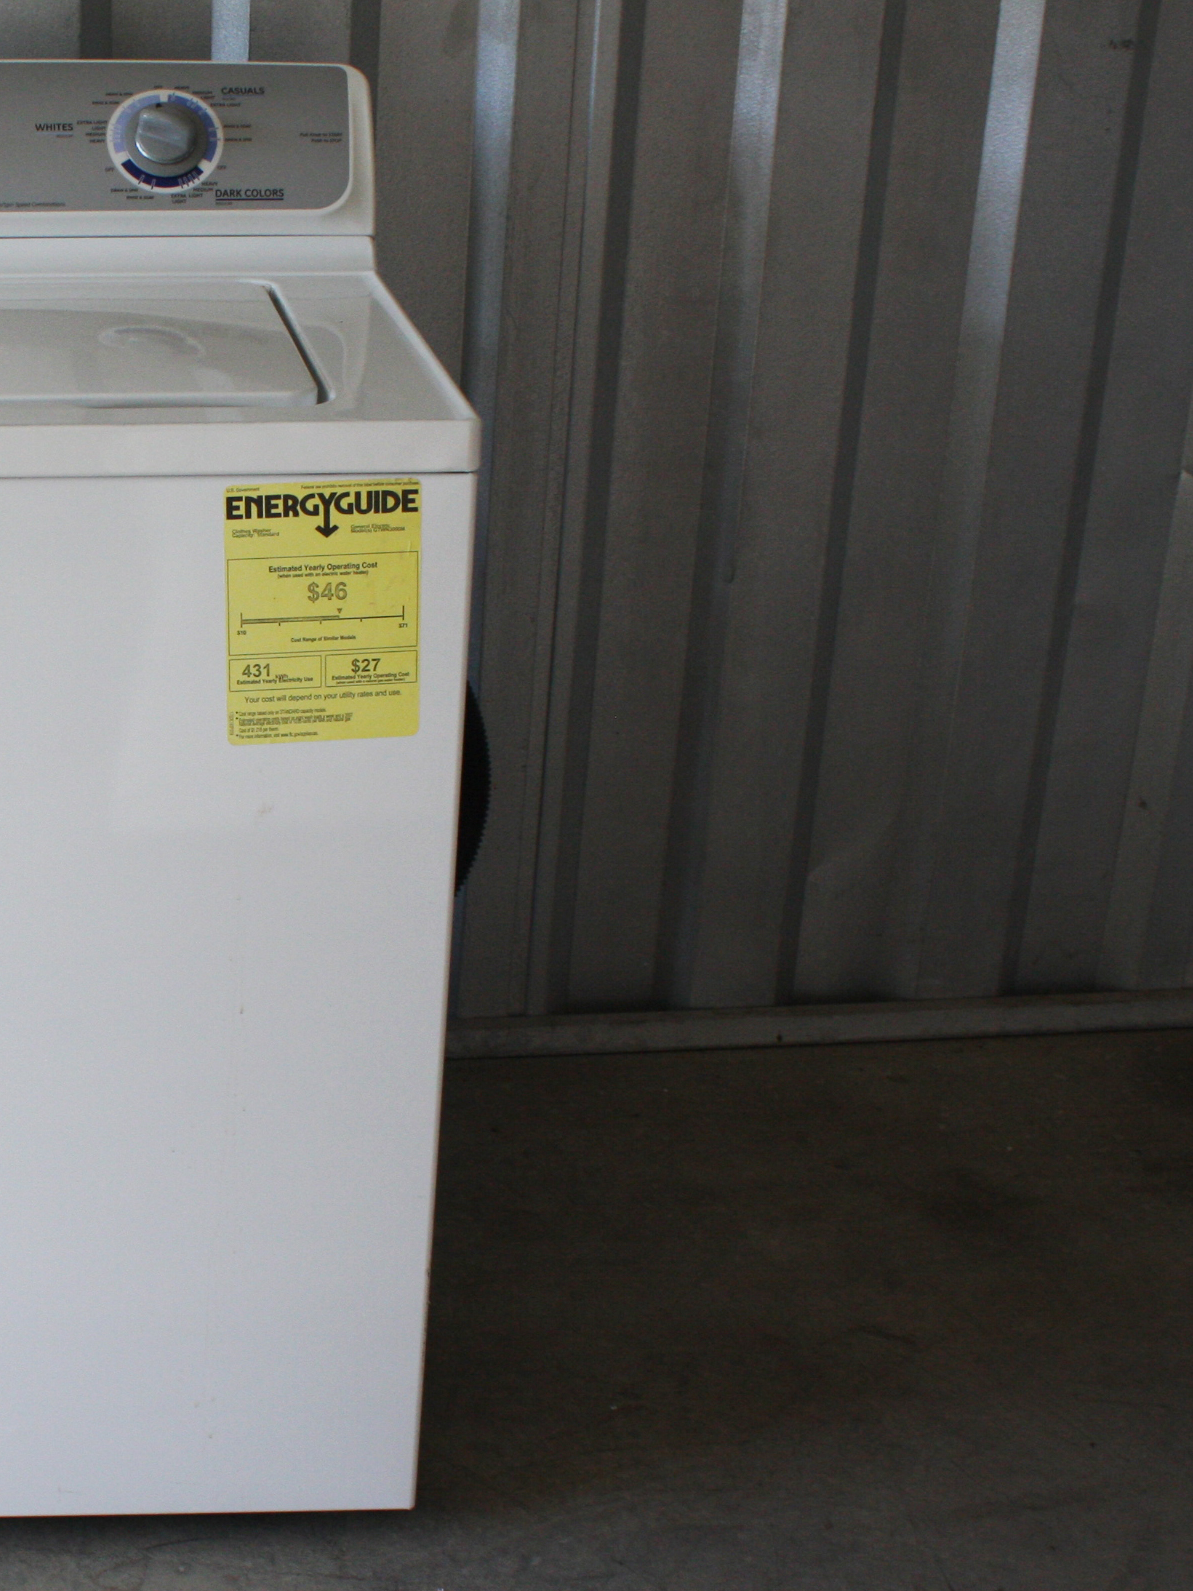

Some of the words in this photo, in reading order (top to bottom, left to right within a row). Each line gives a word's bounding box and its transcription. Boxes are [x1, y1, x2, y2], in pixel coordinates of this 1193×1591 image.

[221, 87, 265, 95] CASUALS
[35, 123, 74, 132] WHITES
[215, 189, 241, 198] DARK
[244, 188, 284, 198] COLORS
[226, 489, 419, 522] ENERGYGUIDE
[268, 565, 302, 573] Estimated
[304, 564, 326, 572] Yearly
[327, 563, 360, 571] Operating
[307, 581, 348, 603] $46
[242, 663, 270, 678] 431
[351, 658, 381, 674] $27
[288, 694, 313, 702] depend
